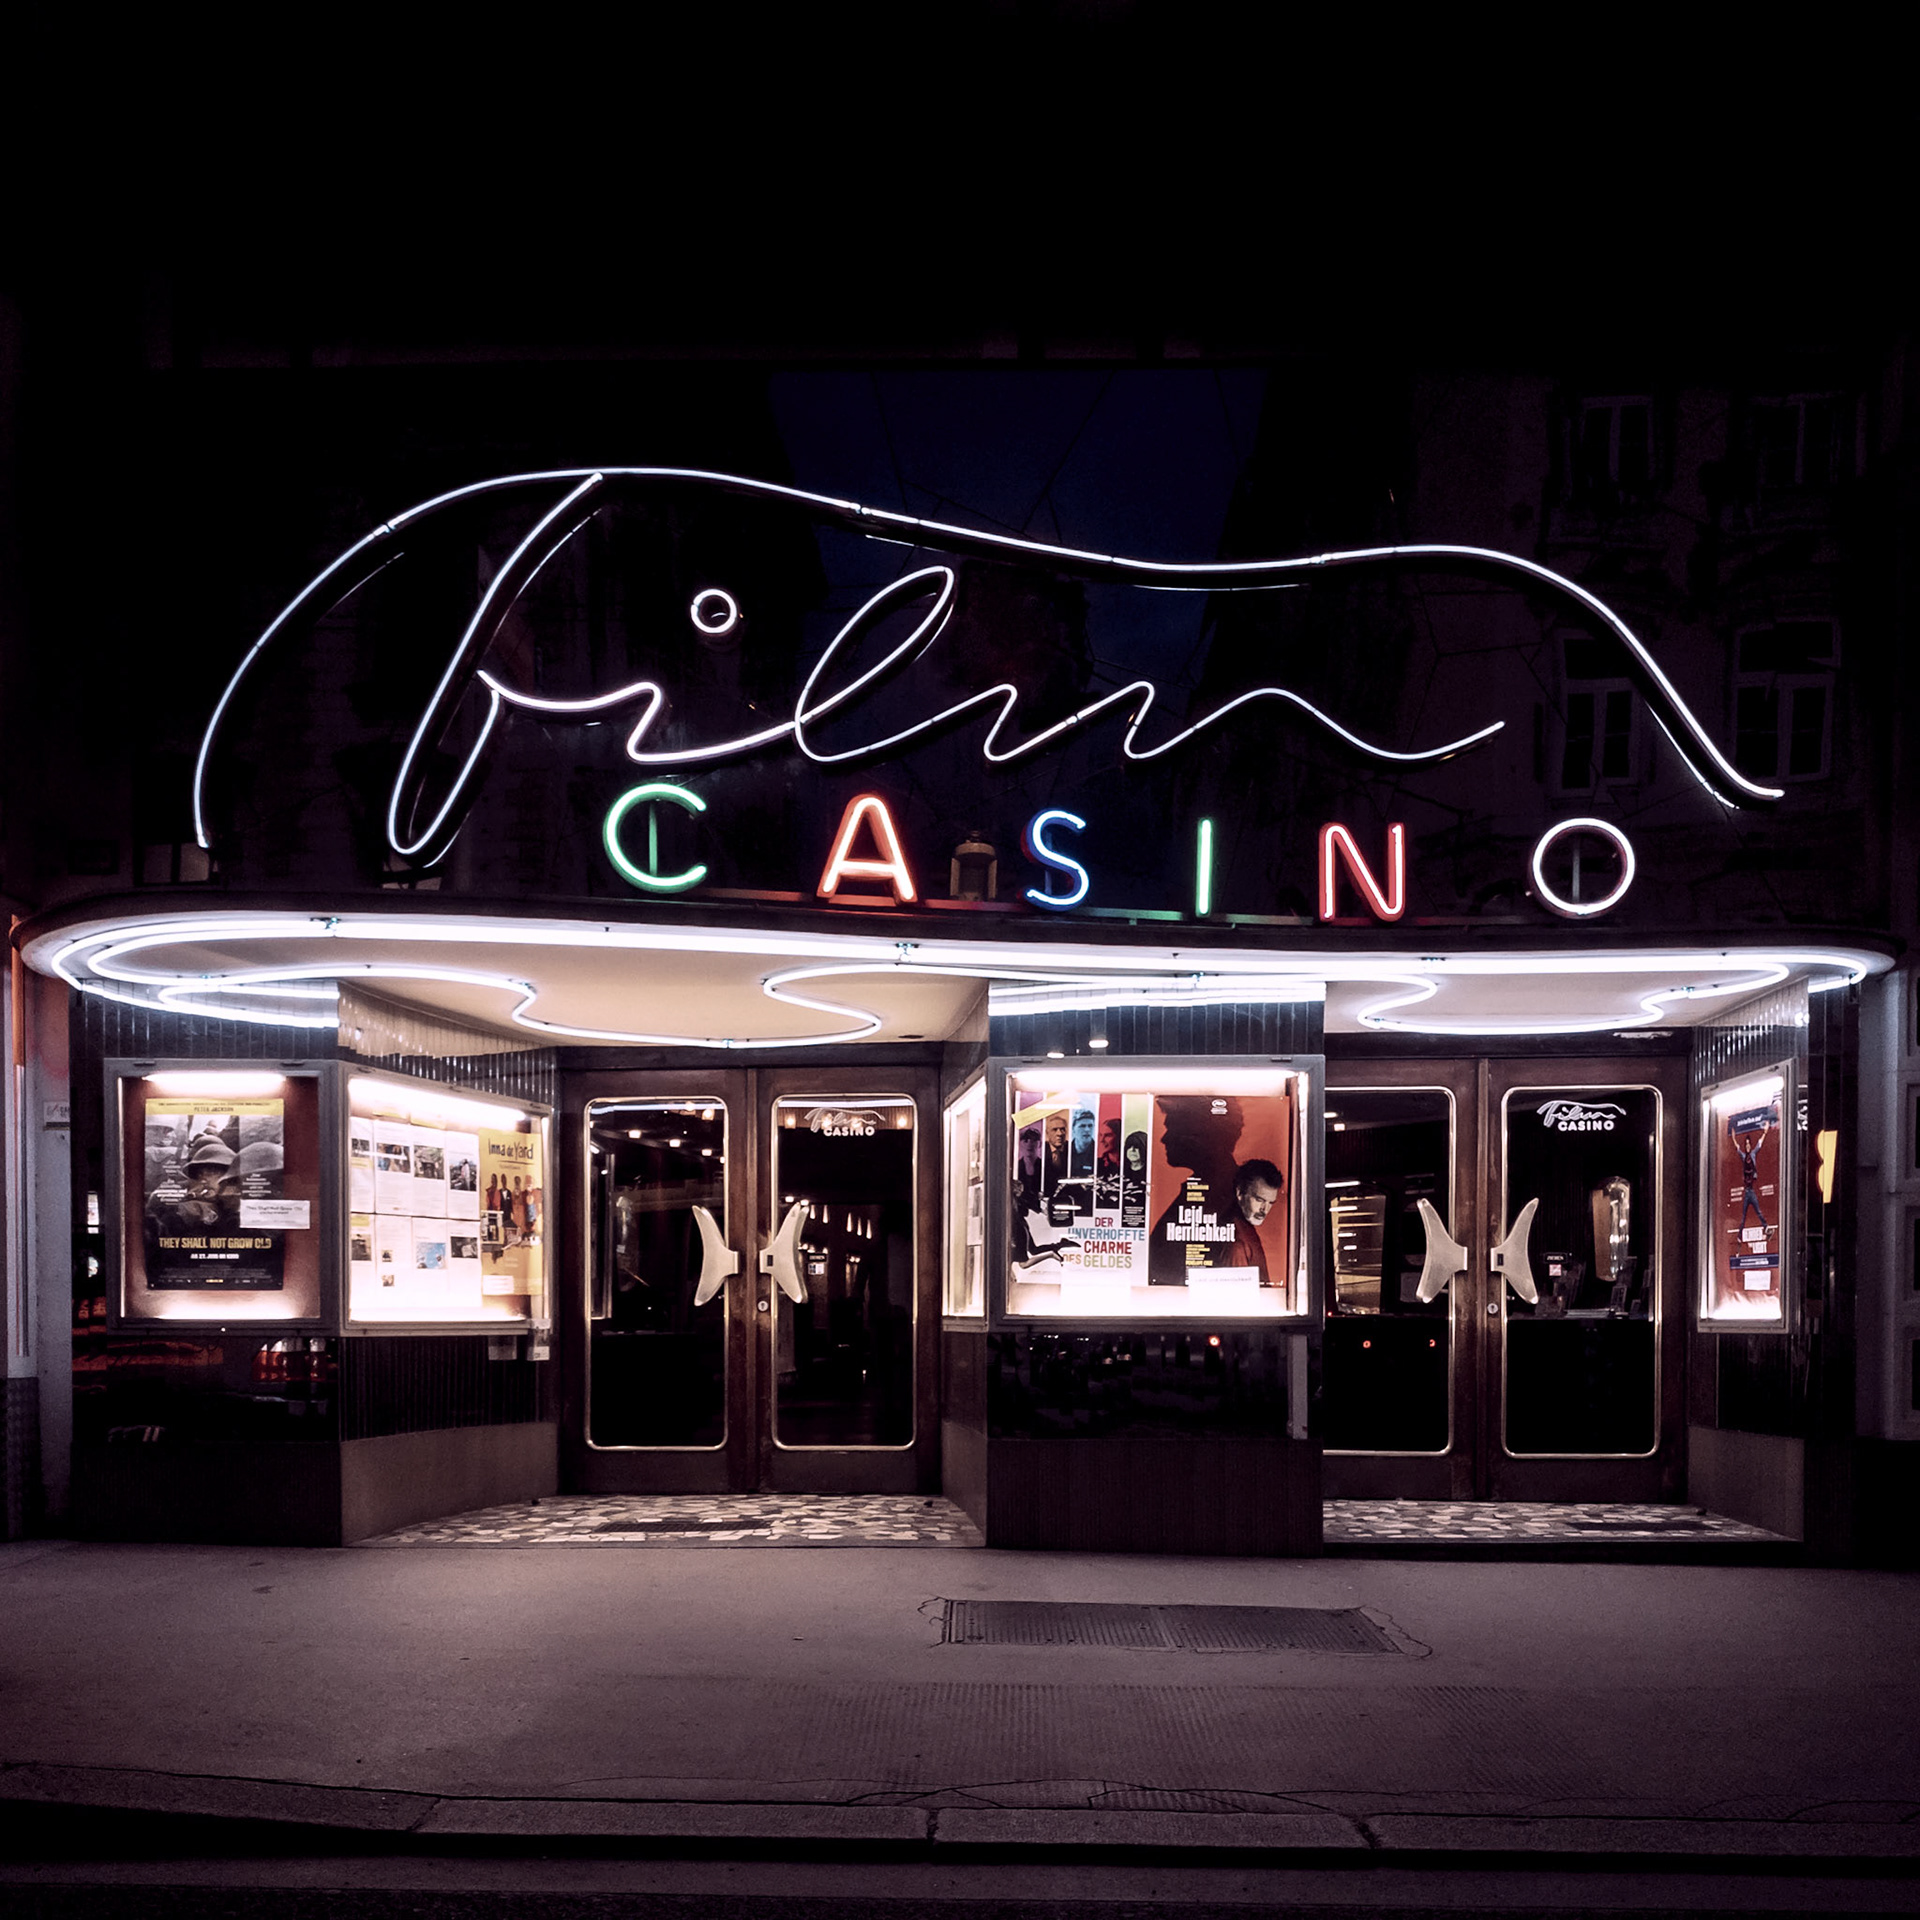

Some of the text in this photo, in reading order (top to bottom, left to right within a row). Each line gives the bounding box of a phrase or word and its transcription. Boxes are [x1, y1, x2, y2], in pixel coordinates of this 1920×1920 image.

[602, 782, 1636, 921] CASINO
[823, 1126, 875, 1137] CASINO
[1557, 1120, 1614, 1132] CASINO
[514, 1141, 533, 1160] Yard
[1178, 1205, 1217, 1224] Leid und
[1094, 1217, 1113, 1227] DER
[1166, 1222, 1236, 1242] Herrlichkeit
[159, 1237, 180, 1249] THEY
[181, 1237, 207, 1249] SHALL
[210, 1237, 226, 1249] NOT
[228, 1237, 253, 1249] GROW
[1083, 1240, 1132, 1255] CHARME
[1083, 1255, 1132, 1269] GELDES
